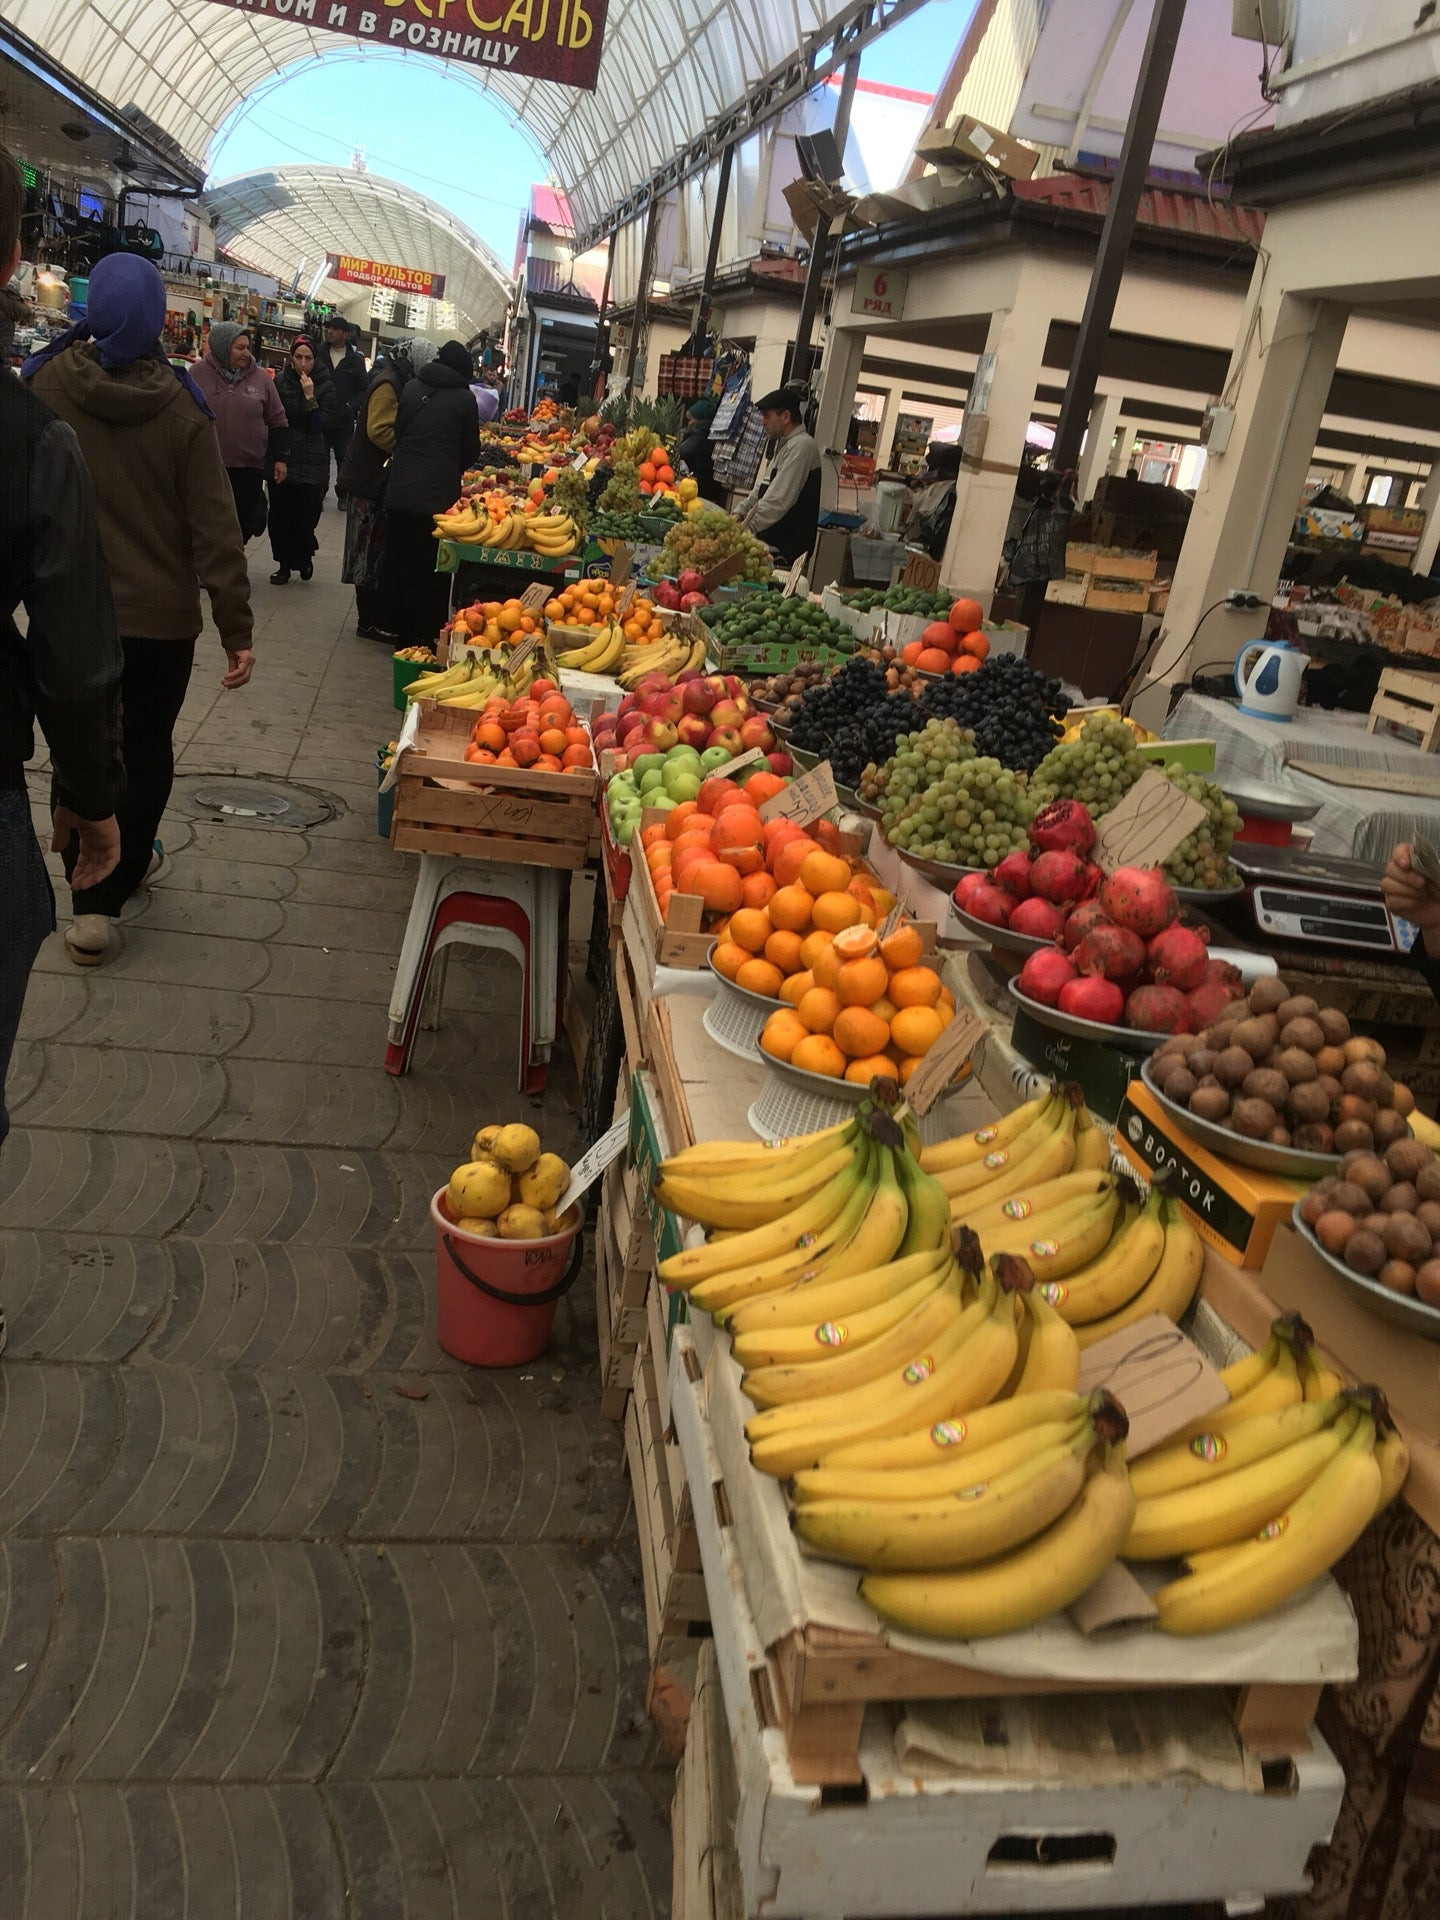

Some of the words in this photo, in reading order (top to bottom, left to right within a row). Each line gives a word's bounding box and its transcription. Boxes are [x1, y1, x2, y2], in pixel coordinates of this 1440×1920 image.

[327, 3, 348, 27] И
[358, 10, 378, 34] В
[389, 17, 519, 66] РОЗНИЦУ
[340, 256, 368, 272] МИР
[371, 263, 432, 286] ПУЛЬТОВ
[346, 270, 381, 282] ПОДБОР
[384, 277, 423, 291] ПУЛЬТОВ
[874, 271, 887, 297] 6
[863, 296, 892, 315] РЯД
[480, 549, 544, 569] KIWI
[752, 646, 836, 668] KIWI
